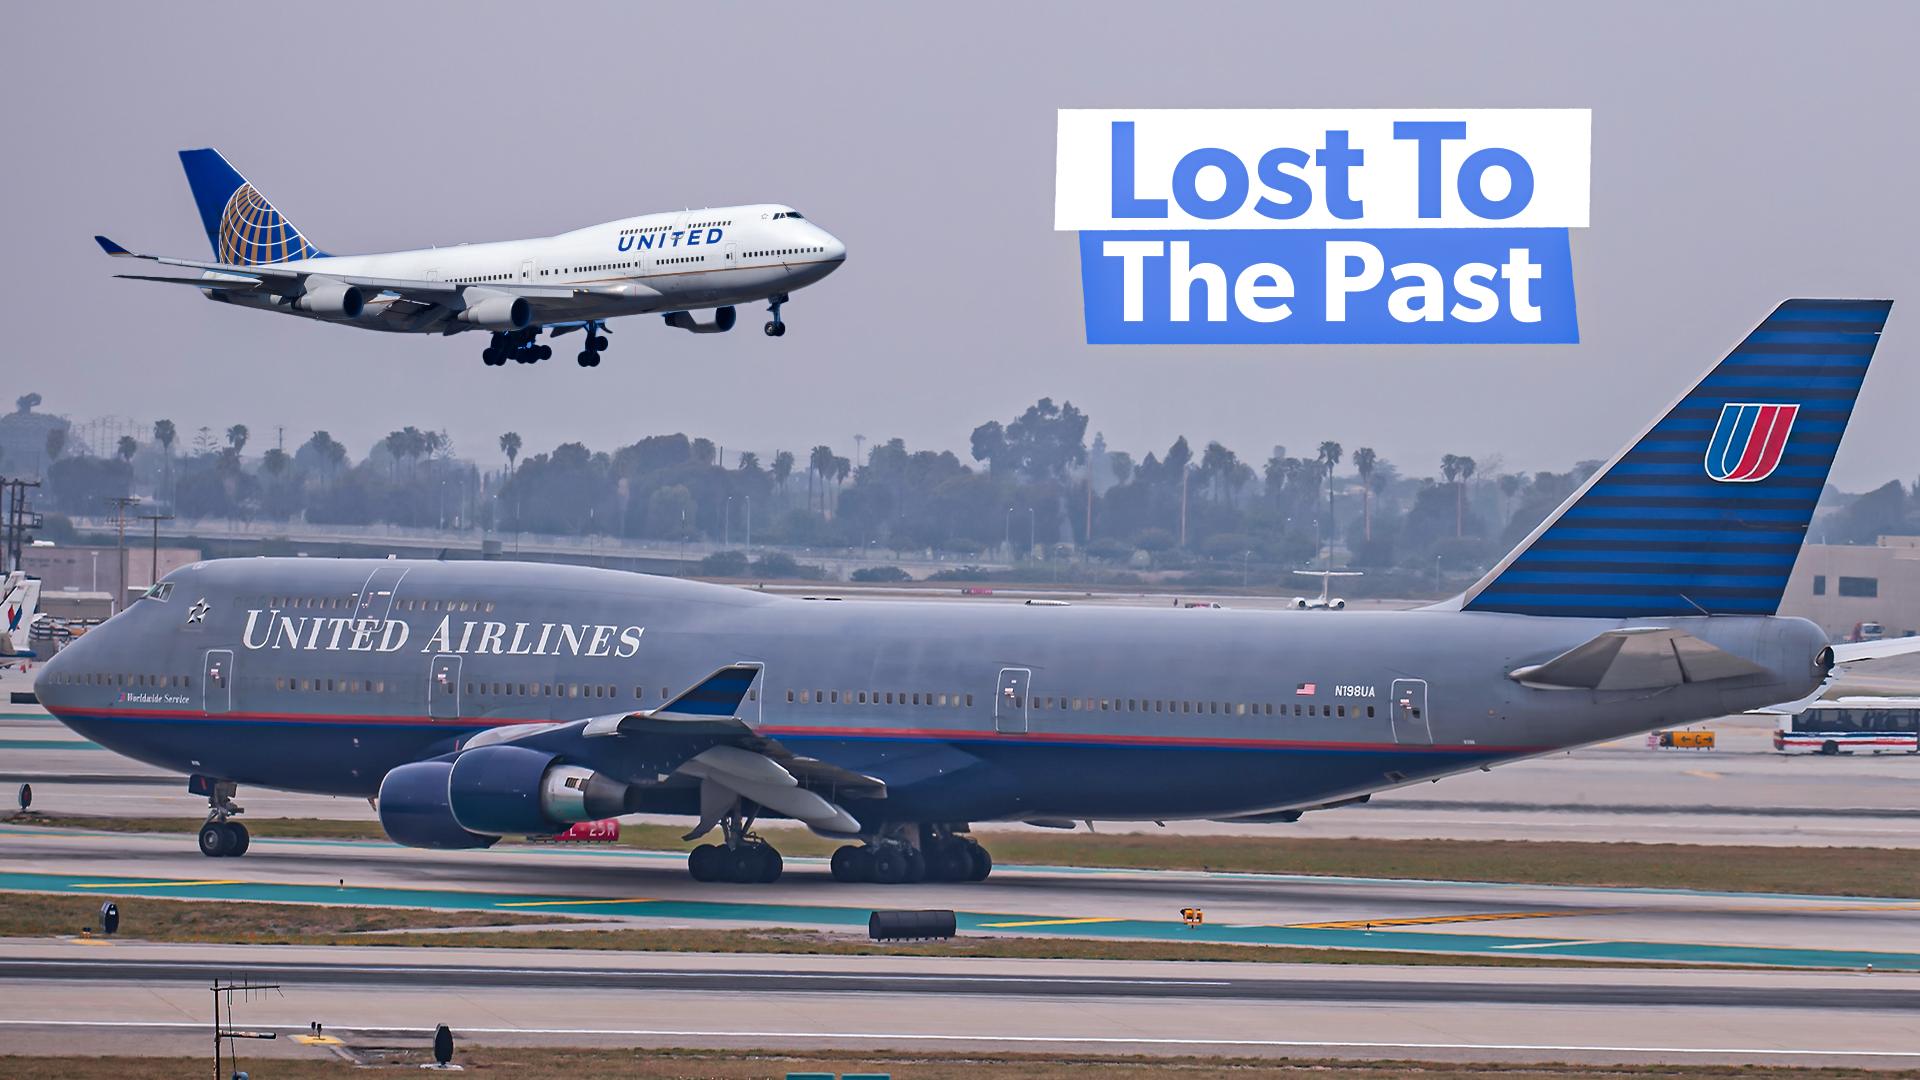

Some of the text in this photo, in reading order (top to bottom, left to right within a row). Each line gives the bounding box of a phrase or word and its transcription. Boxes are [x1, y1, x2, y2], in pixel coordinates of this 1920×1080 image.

[618, 228, 723, 252] UNITED
[242, 610, 645, 658] UNITED AIRLINES
[127, 693, 190, 704] Worldwide Service
[1335, 685, 1375, 697] N198UA
